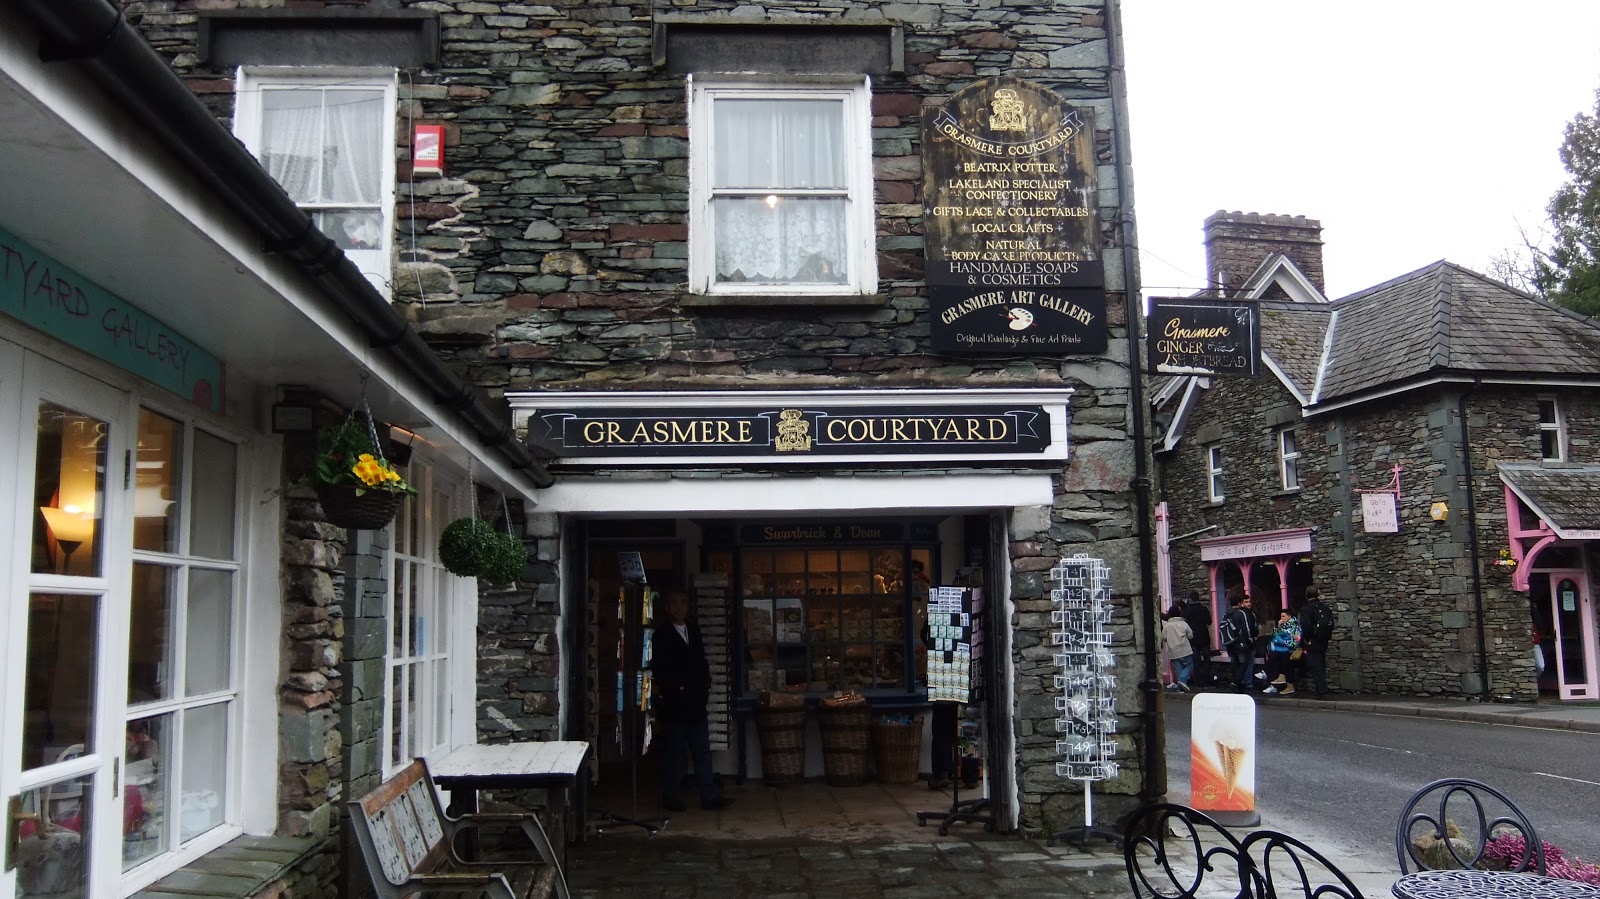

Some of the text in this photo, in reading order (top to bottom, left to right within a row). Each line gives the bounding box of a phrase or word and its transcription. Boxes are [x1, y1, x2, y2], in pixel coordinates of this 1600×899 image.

[943, 123, 1074, 156] GRASMERE COURTYARD
[963, 163, 1058, 173] BEATRIX POTTER
[949, 179, 1071, 189] LAKELAND SPECIALIST
[966, 190, 1059, 200] CONFECTIONERY
[933, 206, 1089, 217] GIFTS LACE & COLLECTABLES
[971, 223, 1054, 233] LOCAL CRAFTS
[985, 240, 1043, 250] NATURAL
[951, 251, 1080, 261] BODY CARE PRODUCTS
[949, 262, 1079, 274] HANDMADE SOAPS
[967, 274, 1061, 285] & COSMETICS
[941, 290, 1096, 327] GRASMERE ART GALLERY
[1164, 317, 1231, 341] Grasmere
[102, 307, 190, 384] GALLERY
[956, 333, 1082, 348] Original Paintings & Fine Art Prints
[1156, 340, 1205, 354] GINGER
[1171, 353, 1247, 368] SHRTBREAD
[583, 418, 1008, 444] GRASMERE COURTYARD
[764, 525, 881, 540] Swarbrick & Dean
[1069, 589, 1082, 597] 42
[1072, 675, 1089, 686] 46
[1073, 741, 1090, 752] 49
[1076, 765, 1091, 774] 50
